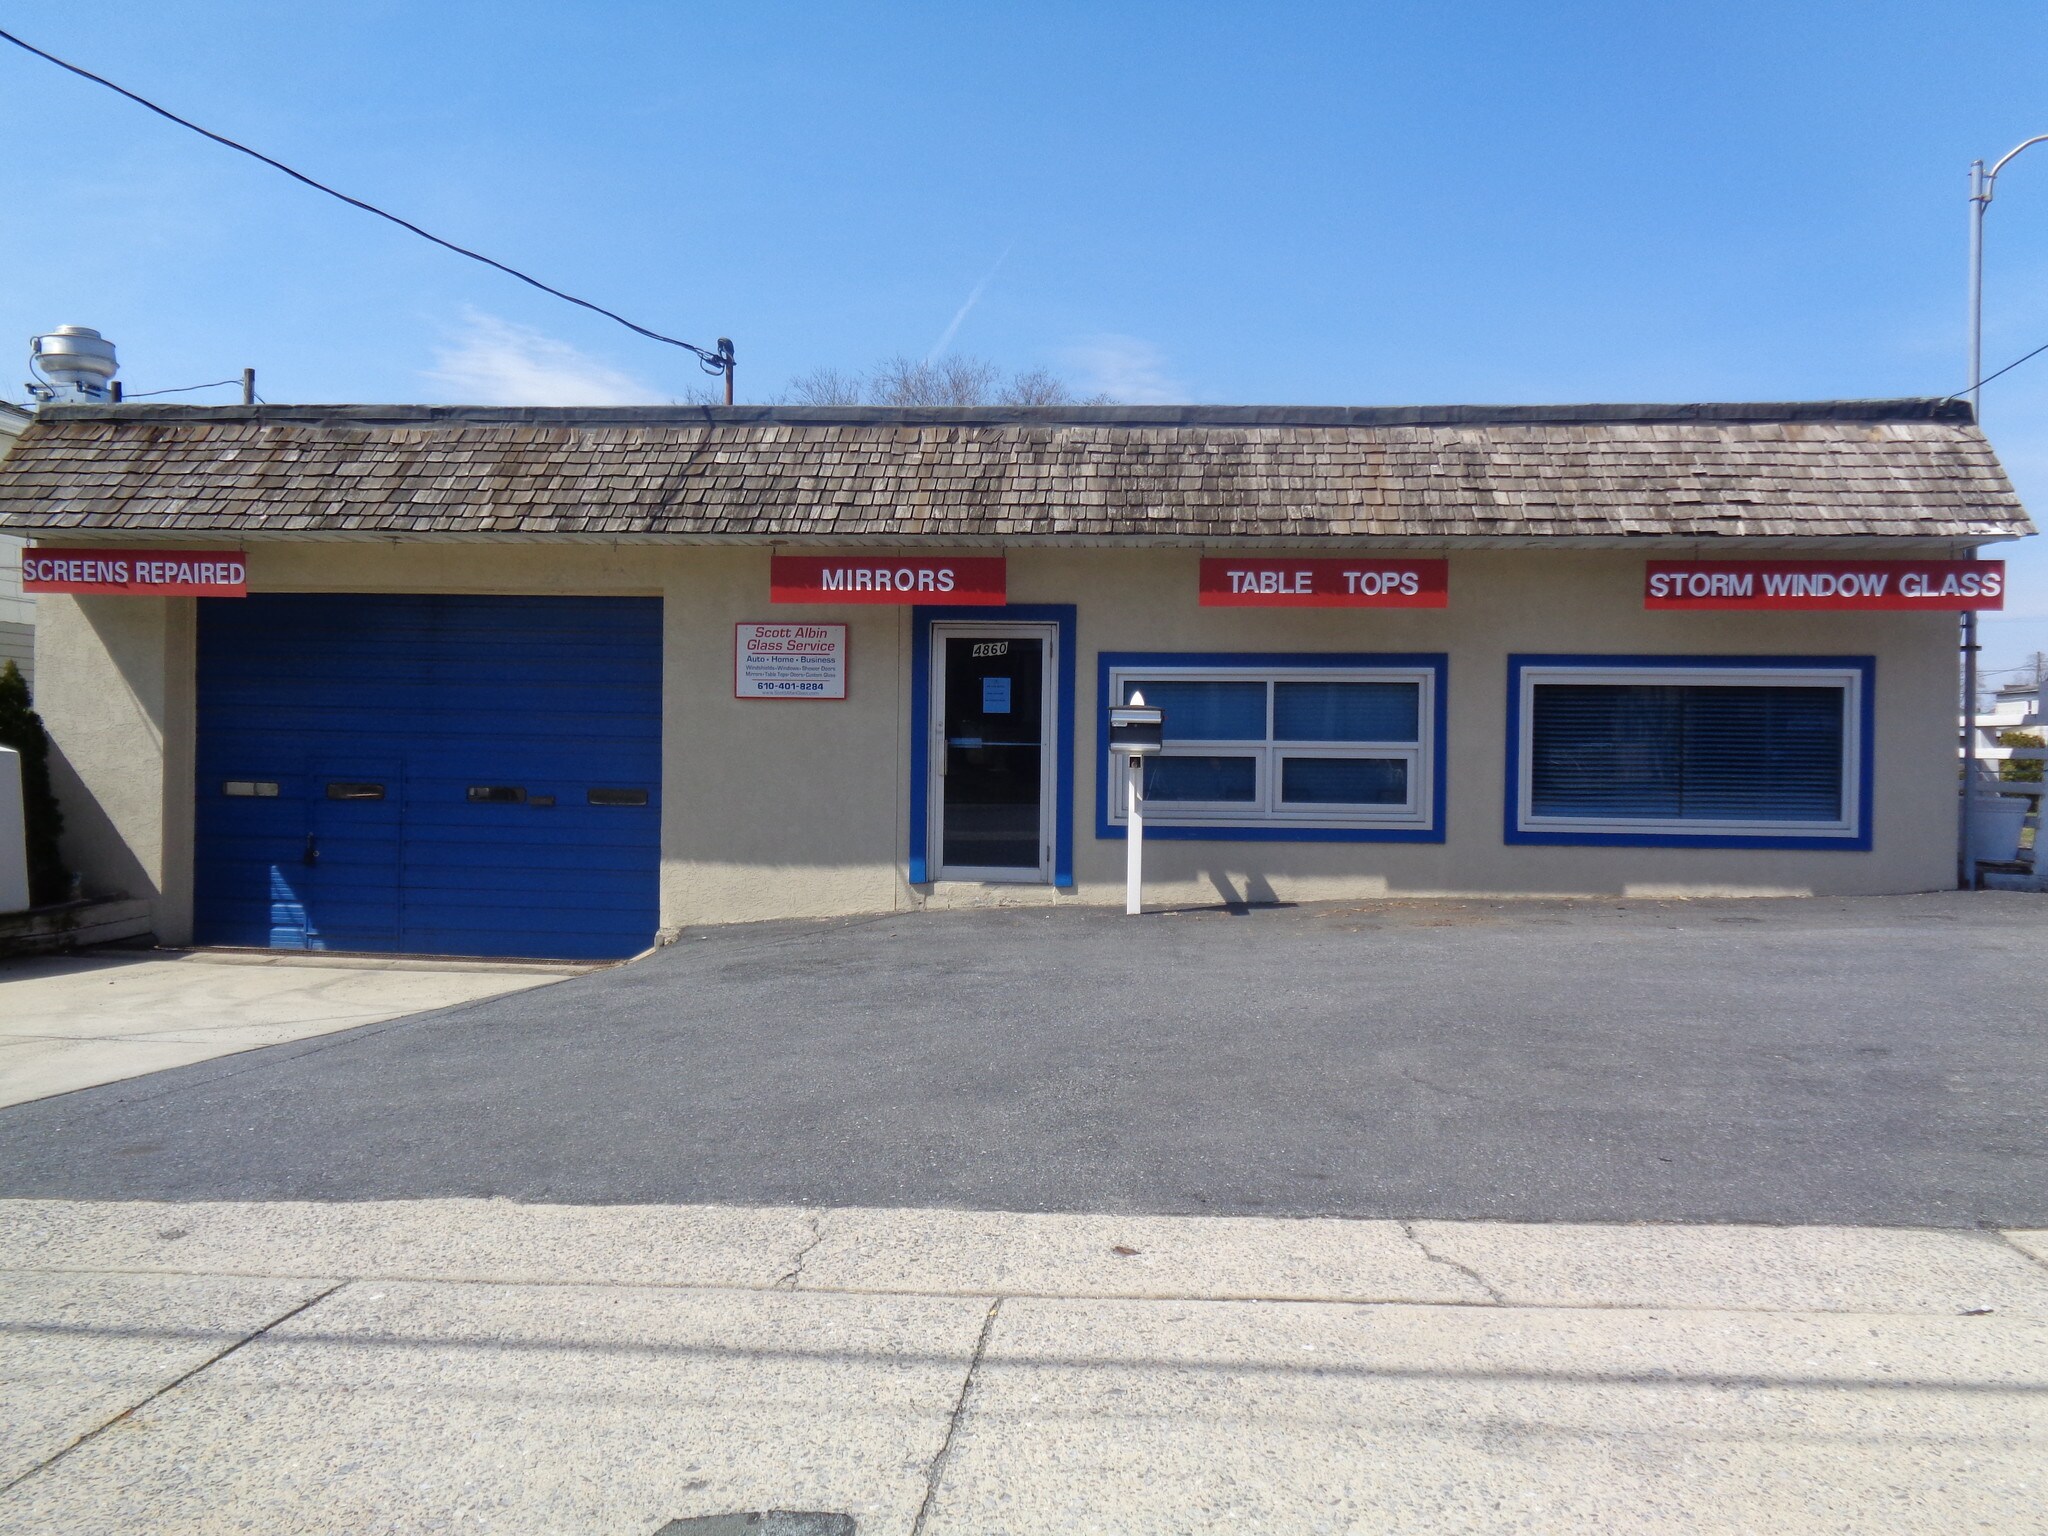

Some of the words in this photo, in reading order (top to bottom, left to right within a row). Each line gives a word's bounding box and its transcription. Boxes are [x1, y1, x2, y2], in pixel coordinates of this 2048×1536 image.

[23, 559, 129, 583] SCREENS
[135, 562, 245, 585] REPAIRED
[822, 568, 955, 592] MIRRORS
[1227, 571, 1313, 594] TABLE
[1343, 572, 1419, 596] TOPS
[1650, 573, 1752, 597] STORM
[1762, 573, 1888, 597] WINDOW
[1899, 573, 2001, 597] GLASS
[755, 627, 791, 638] Scott
[795, 627, 827, 639] Albin
[747, 639, 783, 651] Glass
[787, 640, 835, 652] Service
[973, 643, 1007, 656] 4860
[746, 655, 765, 663] Auto
[800, 656, 836, 664] Business
[757, 682, 824, 691] 610-401-8284
